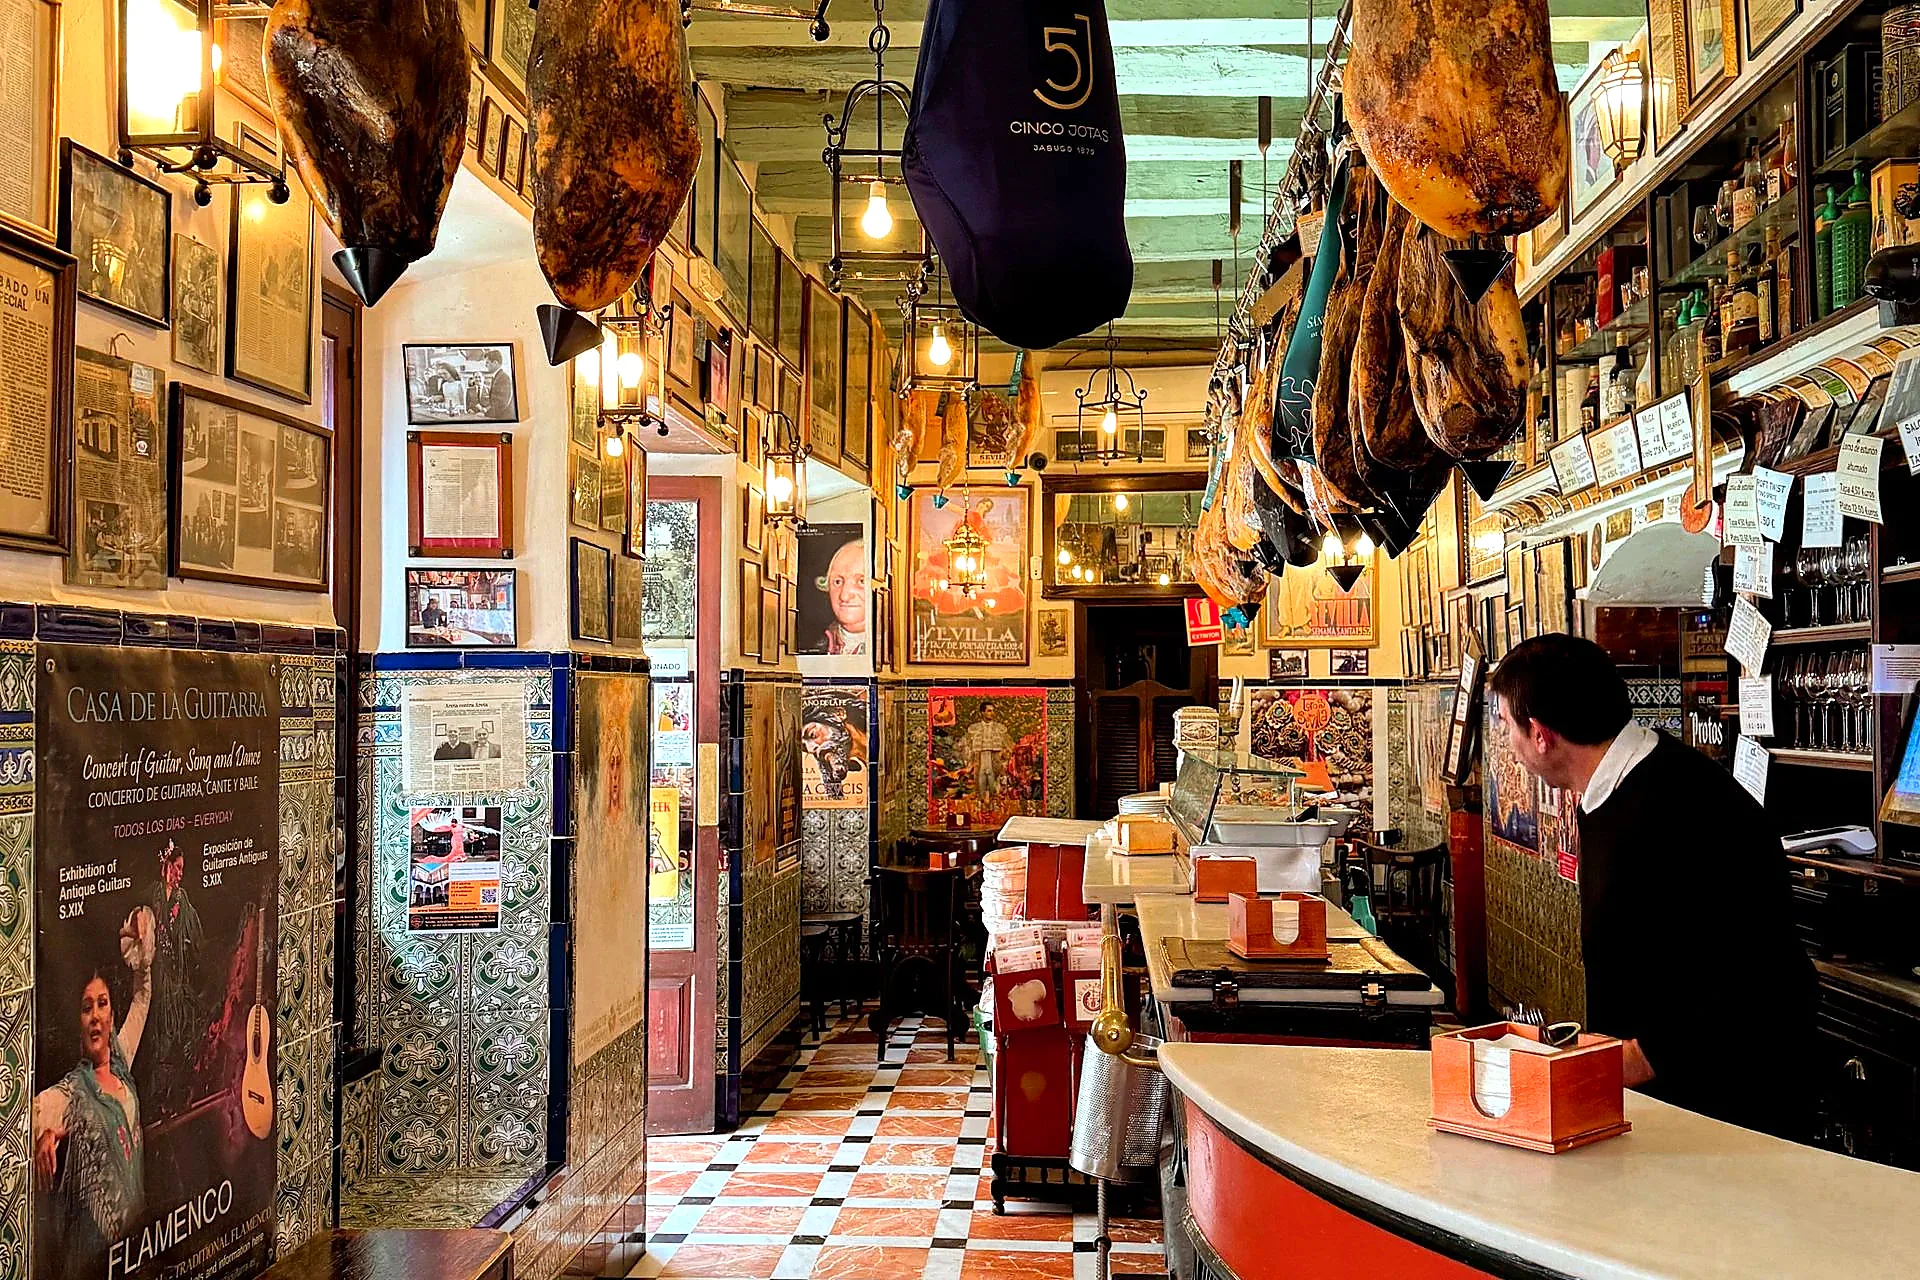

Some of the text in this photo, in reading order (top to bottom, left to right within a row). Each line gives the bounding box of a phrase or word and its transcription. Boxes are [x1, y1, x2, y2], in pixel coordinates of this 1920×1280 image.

[1010, 121, 1109, 143] CINCO JOTAS
[1033, 144, 1073, 153] JABUGO
[35, 288, 49, 305] UN
[812, 418, 837, 448] SEVILLA
[1847, 461, 1868, 474] ahumado
[1840, 482, 1852, 494] Tapa
[1310, 599, 1370, 626] SEVILLA
[922, 626, 1017, 642] SEVILLA
[1191, 631, 1221, 641] EXTINTOR
[1311, 626, 1337, 636] SEMANA
[67, 686, 268, 723] CASA DE LA GUITARRA
[1689, 711, 1723, 747] Protos
[83, 741, 262, 784] Concert of Guitar, Song and Dance
[88, 775, 259, 808] CONCIERTO DE GUITARRA, CANTE Y BAILE
[113, 822, 144, 838] TODOS
[146, 818, 164, 834] LOS
[194, 809, 234, 827] EVERYDAY
[244, 838, 253, 849] de
[59, 858, 119, 883] Exhibition of
[202, 850, 268, 872] Guitarras Antiguas
[59, 876, 132, 901] Antique Guitars
[202, 872, 223, 888] S.XIX
[59, 900, 84, 920] S.XIX
[107, 1179, 233, 1280] FLAMENCO
[230, 1206, 272, 1243] FLAMENCO
[218, 1241, 251, 1272] information
[251, 1232, 265, 1248] here
